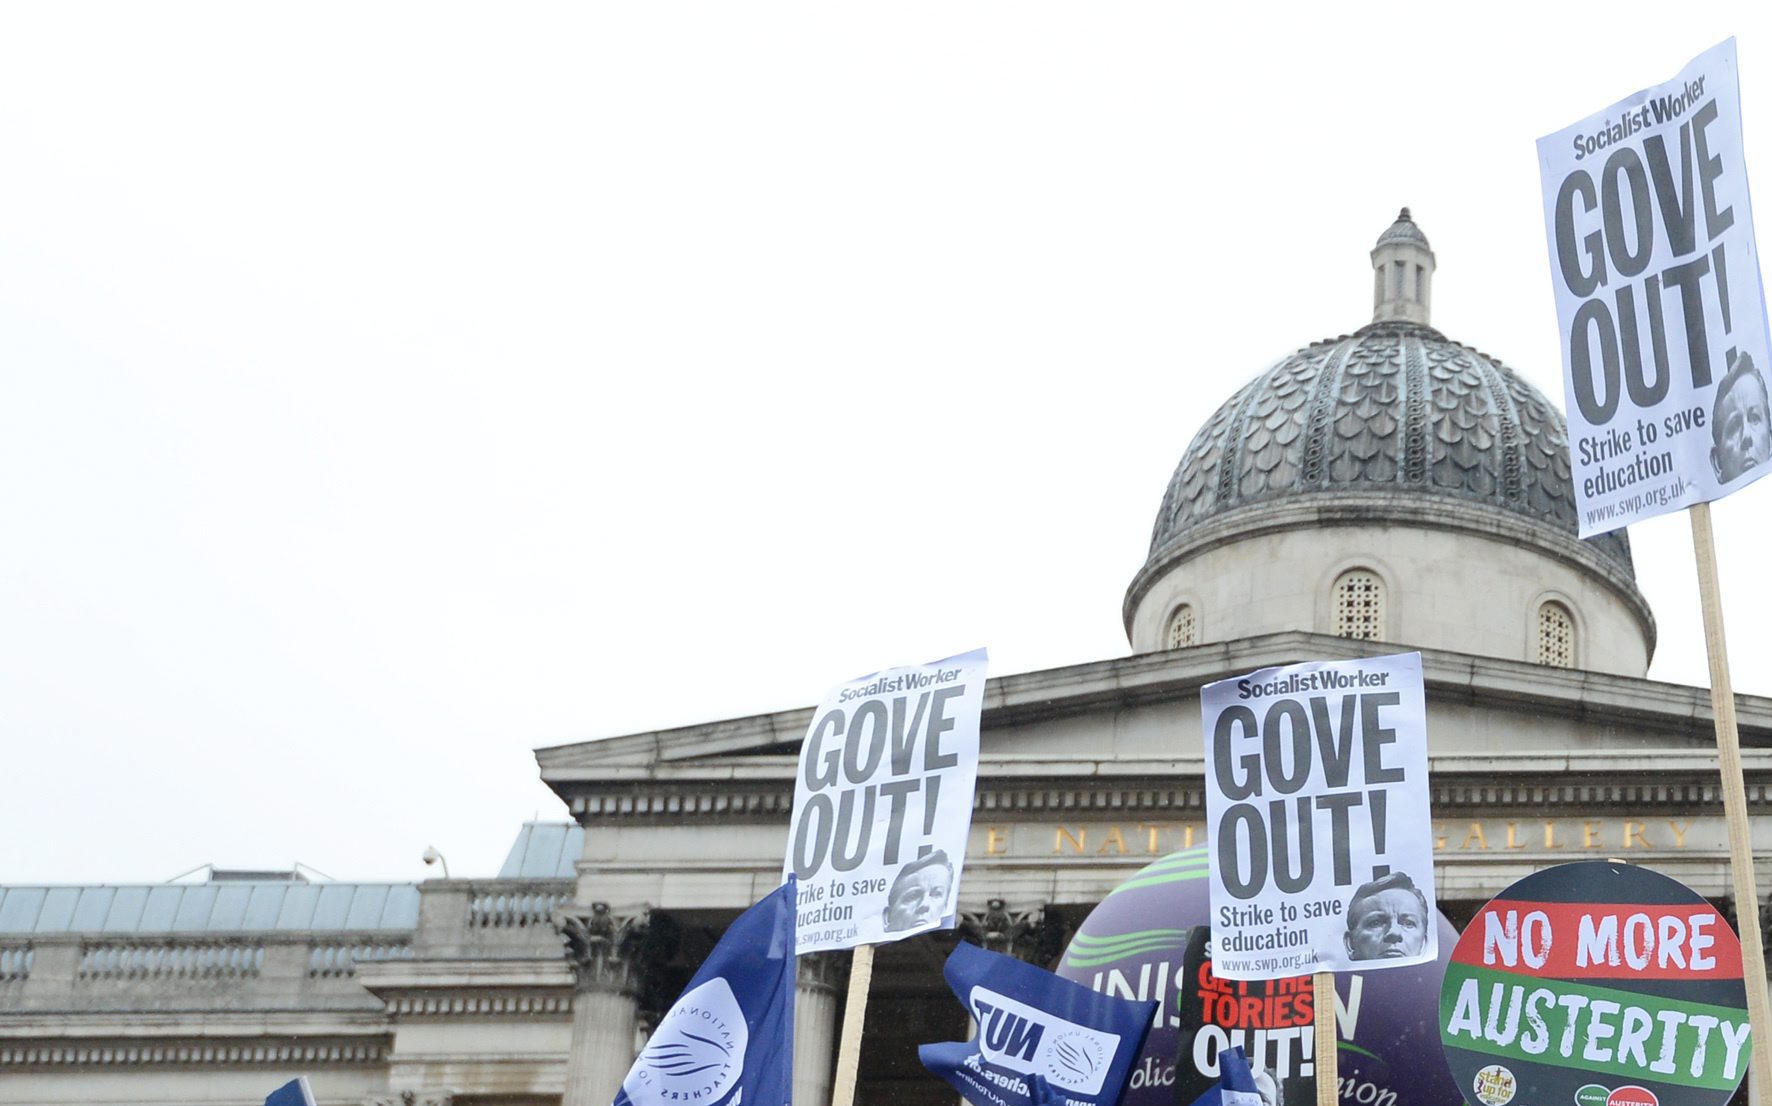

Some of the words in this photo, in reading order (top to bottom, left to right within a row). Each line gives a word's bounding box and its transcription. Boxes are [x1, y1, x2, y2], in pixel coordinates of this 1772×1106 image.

[1555, 97, 1735, 299] GOVE
[1570, 242, 1738, 426] OUT!
[1579, 427, 1633, 466] Strike
[1637, 419, 1659, 444] to
[1664, 406, 1706, 435] save
[1584, 449, 1674, 498] education
[1586, 479, 1686, 526] www.swp.org.uk
[804, 684, 965, 792] GOVE
[1213, 691, 1405, 801] GOVE
[792, 775, 941, 880] OUT!
[1218, 789, 1391, 900] OUT!
[796, 884, 824, 906] trike
[830, 879, 845, 898] to
[851, 877, 887, 896] save
[797, 903, 853, 927] ucation
[1220, 904, 1273, 927] Strike
[1280, 900, 1297, 921] to
[1304, 898, 1342, 919] save
[1221, 928, 1308, 952] education
[1222, 948, 1319, 972] www.swp.org.uk
[1483, 910, 1552, 969] NO
[1576, 913, 1716, 970] MORE
[1198, 991, 1314, 1028] TORIES
[1447, 978, 1752, 1079] AUSTERITY
